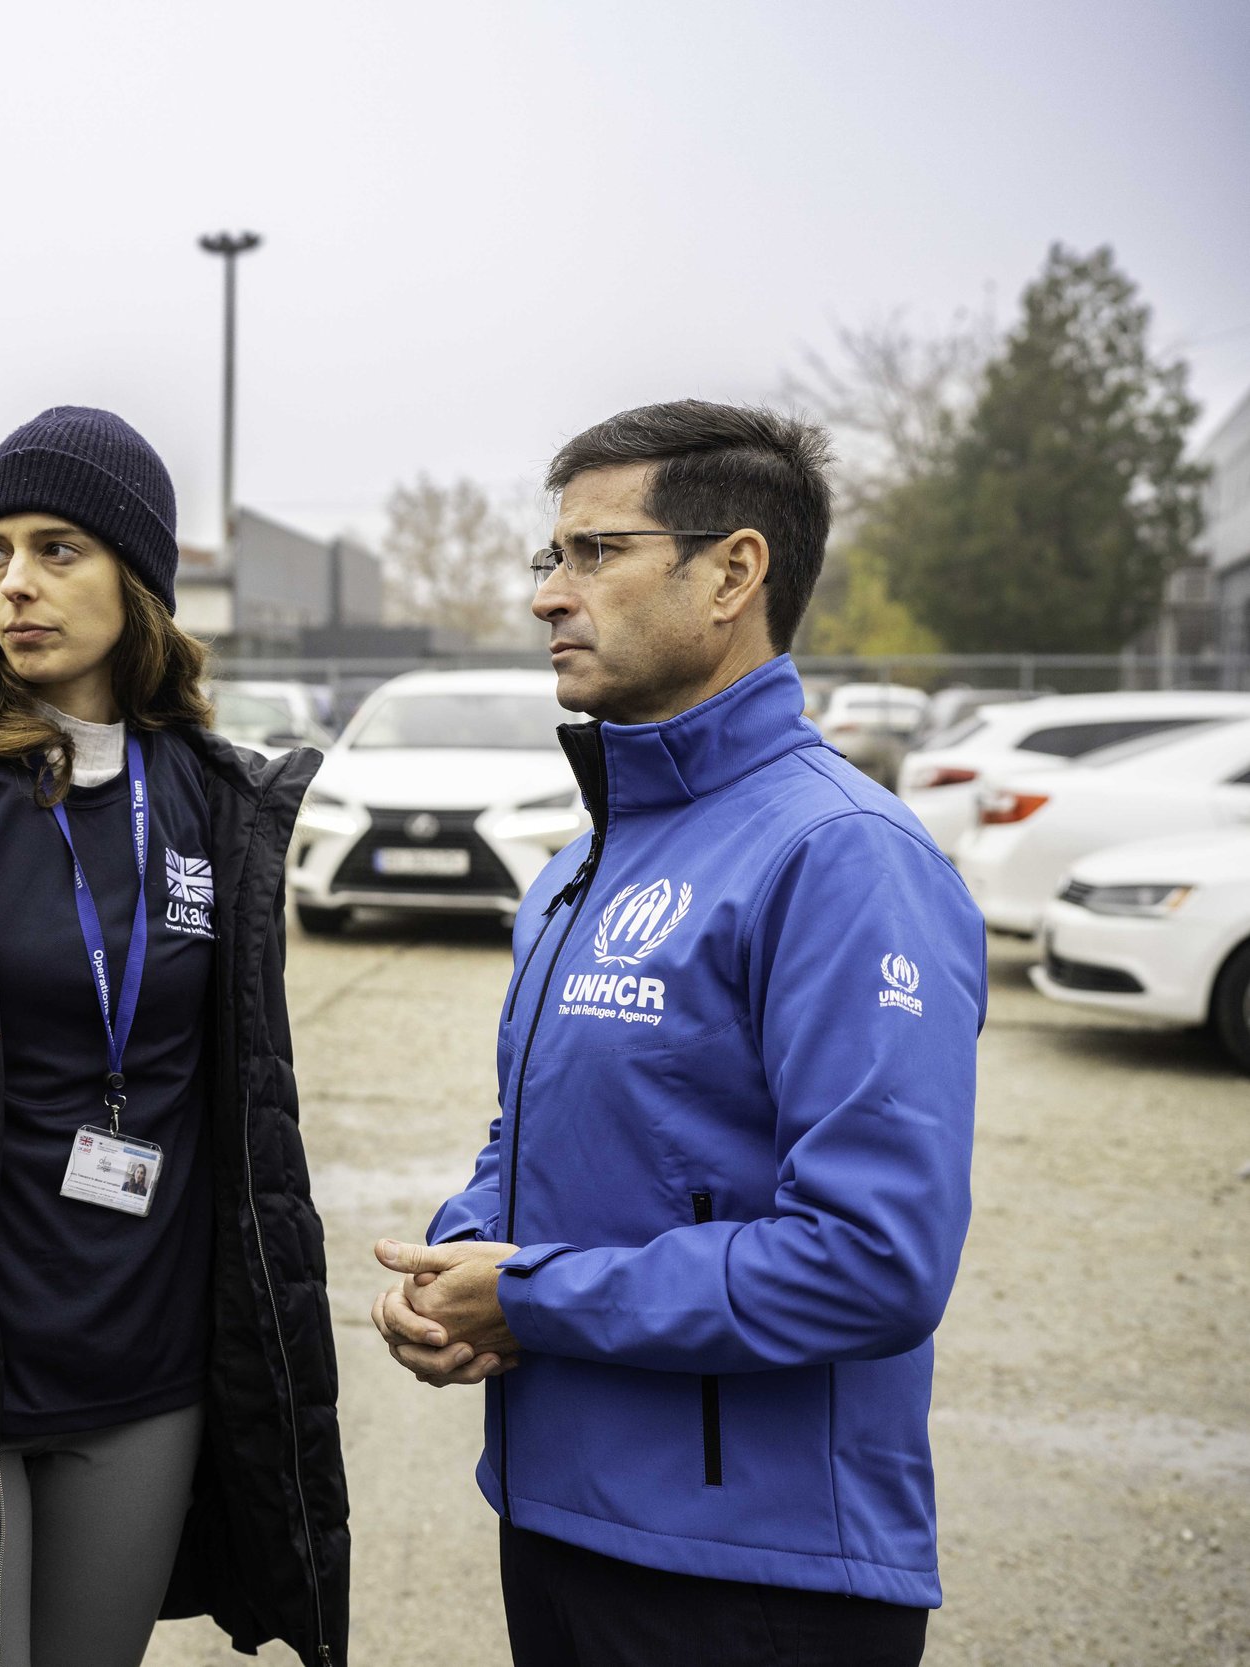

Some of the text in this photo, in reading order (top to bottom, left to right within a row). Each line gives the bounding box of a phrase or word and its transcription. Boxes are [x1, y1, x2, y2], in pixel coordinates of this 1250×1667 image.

[133, 780, 144, 875] Operations Team
[74, 858, 83, 889] eam
[93, 949, 109, 1016] Operations
[562, 974, 666, 1011] UNHCR
[558, 1004, 662, 1026] The UN Refugee Agency
[879, 990, 922, 1012] UNHCR
